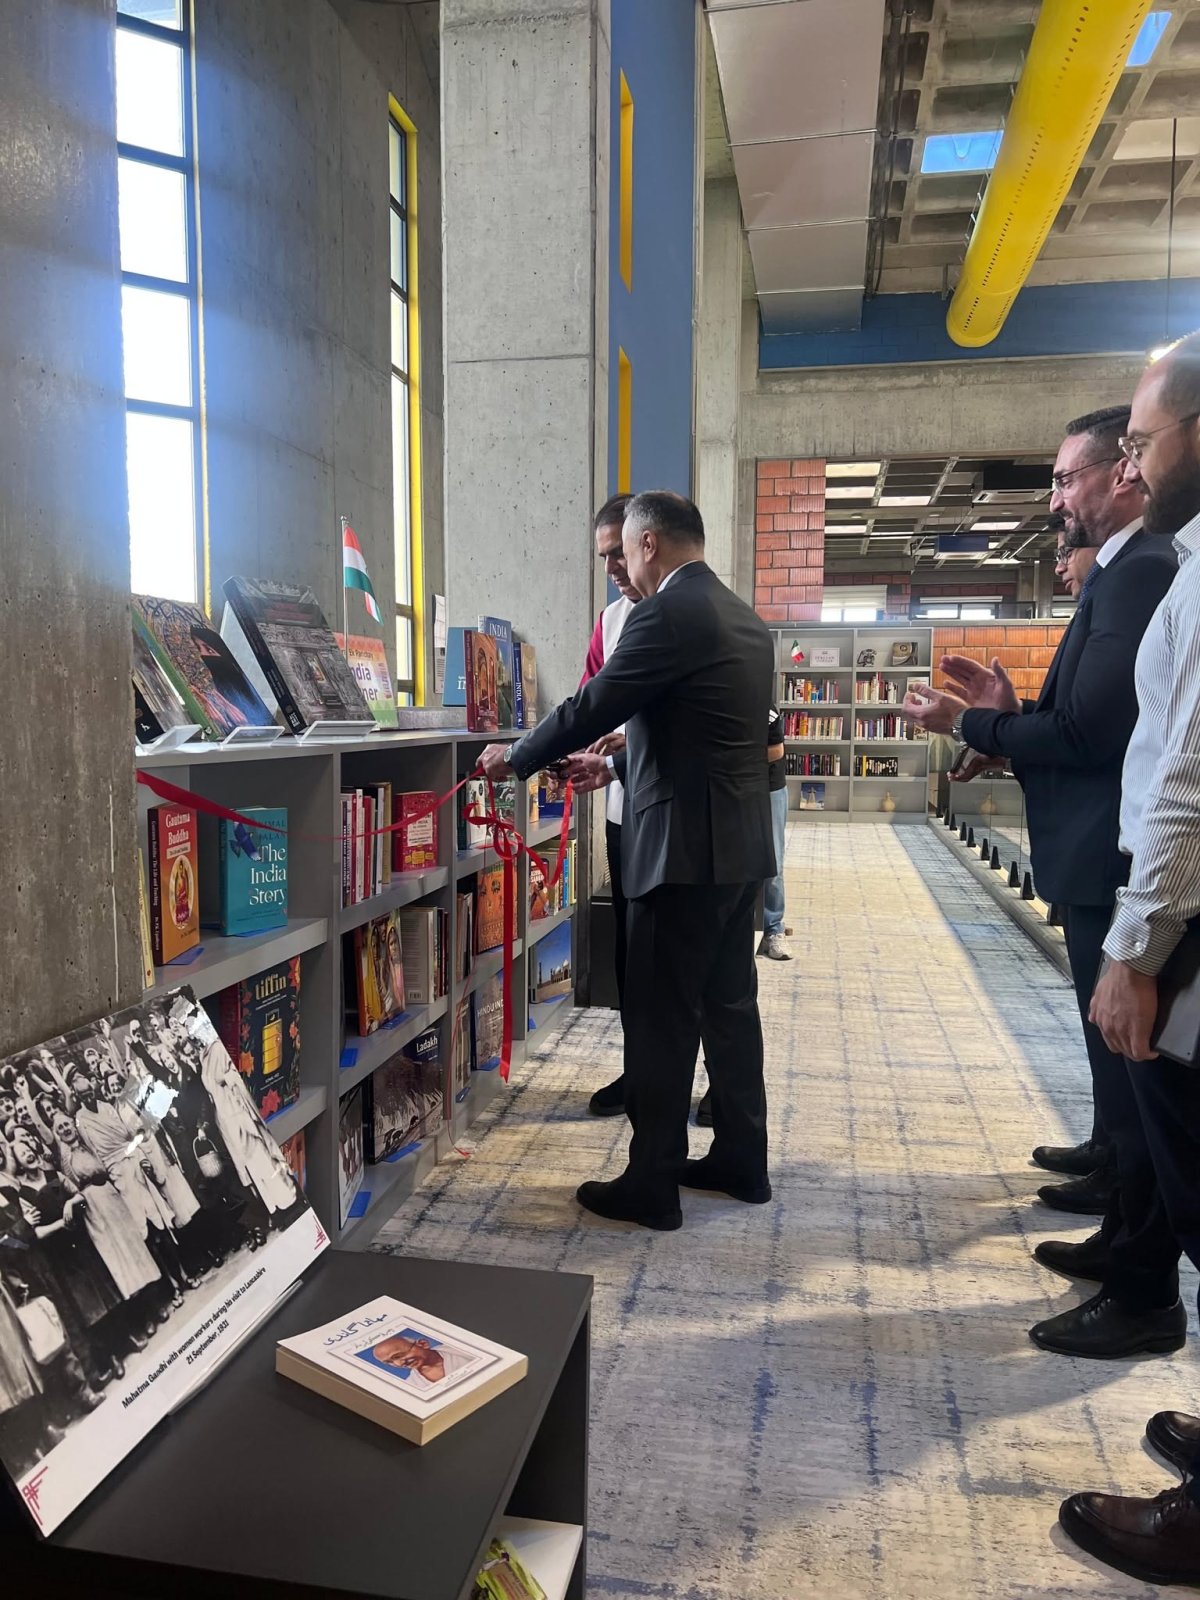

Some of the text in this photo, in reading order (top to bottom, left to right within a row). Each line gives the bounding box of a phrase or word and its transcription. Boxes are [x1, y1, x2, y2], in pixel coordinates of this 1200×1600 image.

[489, 623, 508, 638] INDIA
[166, 813, 190, 828] Gautama
[168, 829, 189, 846] Buddha
[258, 844, 286, 862] The
[250, 864, 286, 884] India
[249, 888, 285, 906] Story
[256, 974, 287, 1000] tiffin
[416, 1035, 438, 1053] Ladakh
[121, 1380, 150, 1409] Mahatma
[148, 1360, 168, 1382] Gandhi
[166, 1351, 179, 1366] with
[178, 1336, 195, 1355] women
[194, 1318, 213, 1339] workers
[212, 1305, 228, 1321] during
[224, 1299, 233, 1308] his
[232, 1290, 242, 1302] visit
[244, 1267, 266, 1290] Lancashire
[186, 1354, 194, 1365] 21
